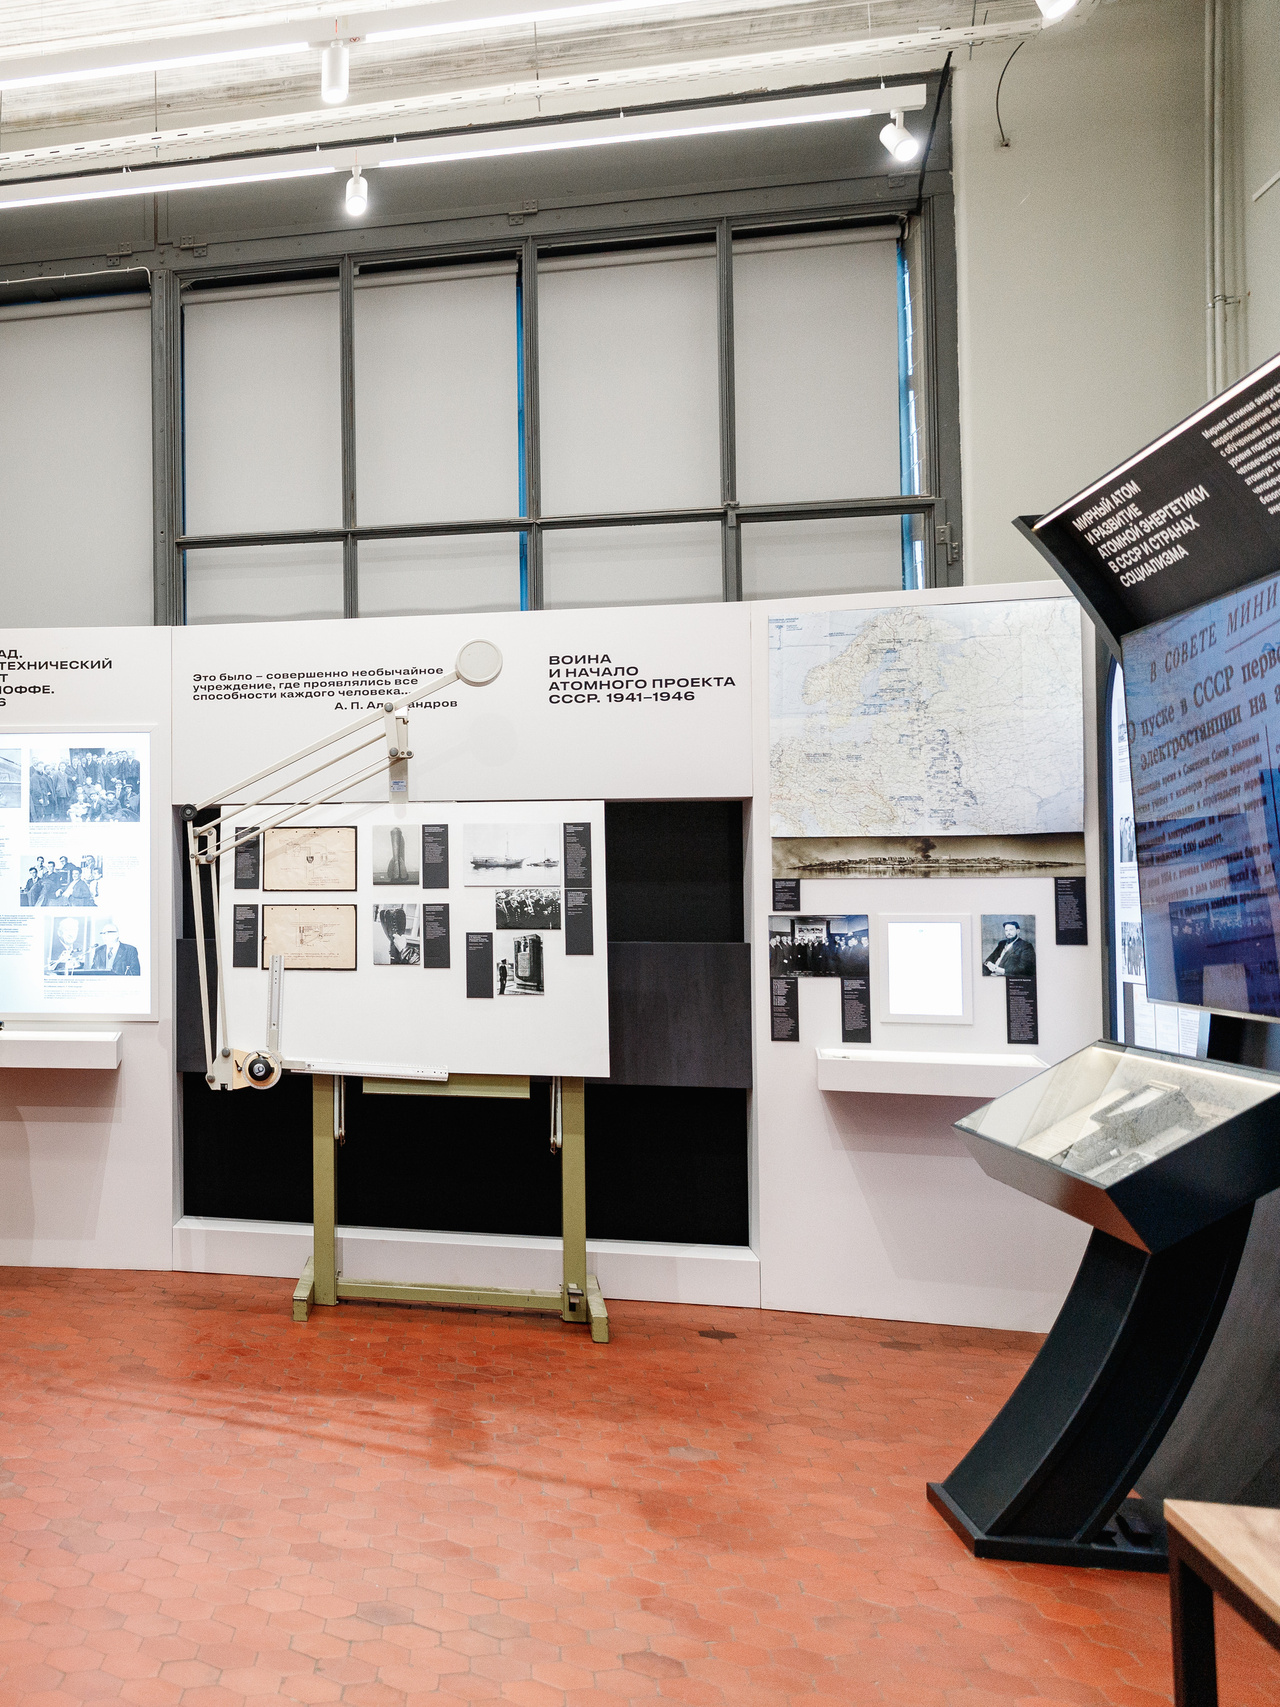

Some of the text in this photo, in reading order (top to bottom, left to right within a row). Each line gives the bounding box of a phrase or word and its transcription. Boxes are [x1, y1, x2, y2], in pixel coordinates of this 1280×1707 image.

[1201, 382, 1280, 440] Мирная атомная энерге
[1224, 427, 1262, 455] обученным
[1260, 422, 1272, 433] на
[1228, 448, 1253, 469] уровня
[1244, 465, 1274, 486] атомную
[1072, 479, 1142, 532] МИРНЫЙ АТОМ
[1097, 484, 1210, 560] АТОМНОЙ ЭНЕРГЕТИКИ
[1083, 502, 1143, 546] И РАЗВИТИЕ
[1107, 513, 1200, 574] В СССР И СТРАНАХ
[1119, 543, 1189, 588] СОЦИАЛИЗМА
[1164, 622, 1217, 674] СОВЕТЕ
[1226, 581, 1278, 637] МИНИ
[192, 673, 217, 682] Это
[219, 671, 253, 681] было
[266, 669, 349, 681] совершенно
[351, 665, 444, 678] необычайное
[192, 677, 419, 693] учреждение, где проявлялись все
[548, 666, 639, 678] И НАЧАЛО
[548, 676, 736, 691] АТОМНОГО ПРОЕКТА
[192, 691, 277, 702] способности
[279, 688, 335, 700] каждого
[334, 700, 458, 711] А. П. Аландров
[548, 691, 696, 704] СССР. 1941–1946
[1141, 704, 1175, 737] пуске
[1193, 664, 1235, 708] СССР
[1140, 704, 1242, 771] электростанции
[1249, 691, 1267, 718] на
